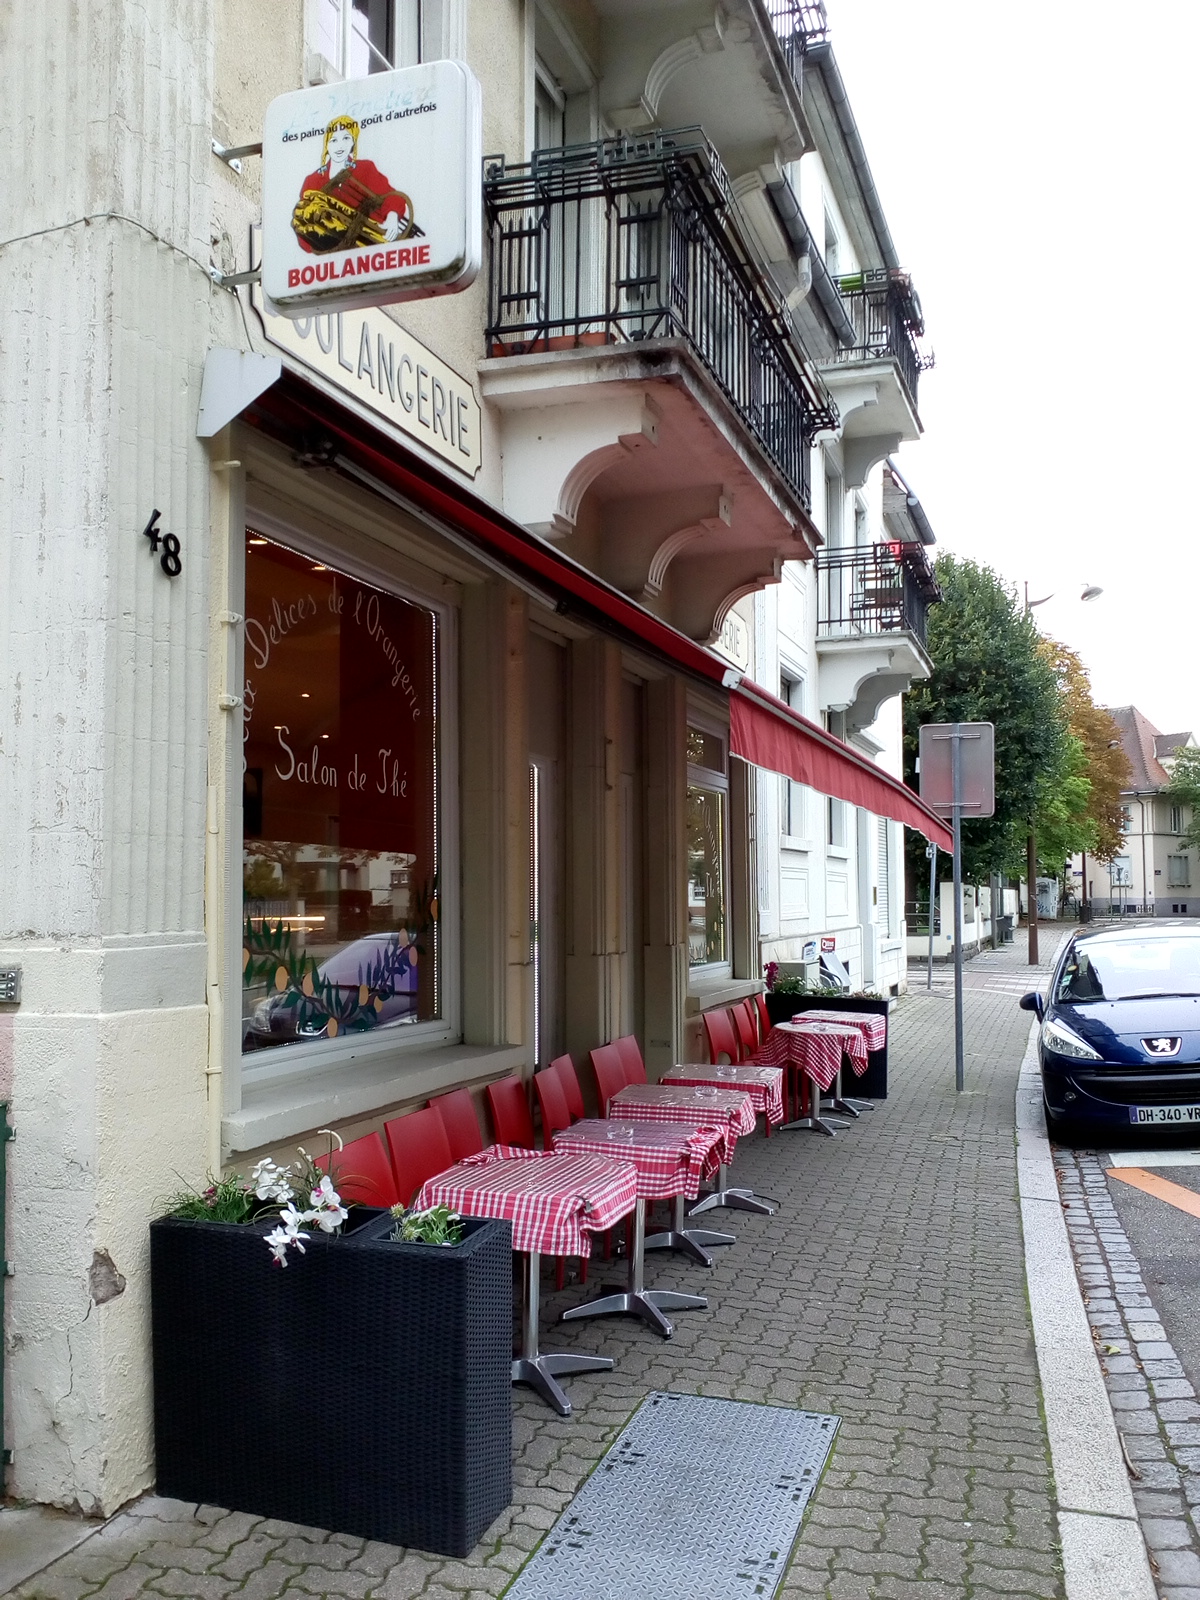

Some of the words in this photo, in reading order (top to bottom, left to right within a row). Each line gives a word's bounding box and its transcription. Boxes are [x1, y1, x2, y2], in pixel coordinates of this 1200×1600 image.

[282, 132, 299, 143] des
[300, 125, 325, 142] pains
[326, 123, 338, 134] au
[339, 119, 358, 132] bon
[361, 112, 383, 130] goût
[385, 101, 437, 122] d'autrefois
[288, 244, 431, 289] BOULANGERIE
[143, 508, 182, 577] 48
[244, 594, 317, 670] Délices
[328, 576, 344, 614] de
[352, 590, 421, 722] l'Orangerie
[274, 725, 338, 788] Salon
[347, 753, 367, 791] de
[376, 748, 407, 798] Thé
